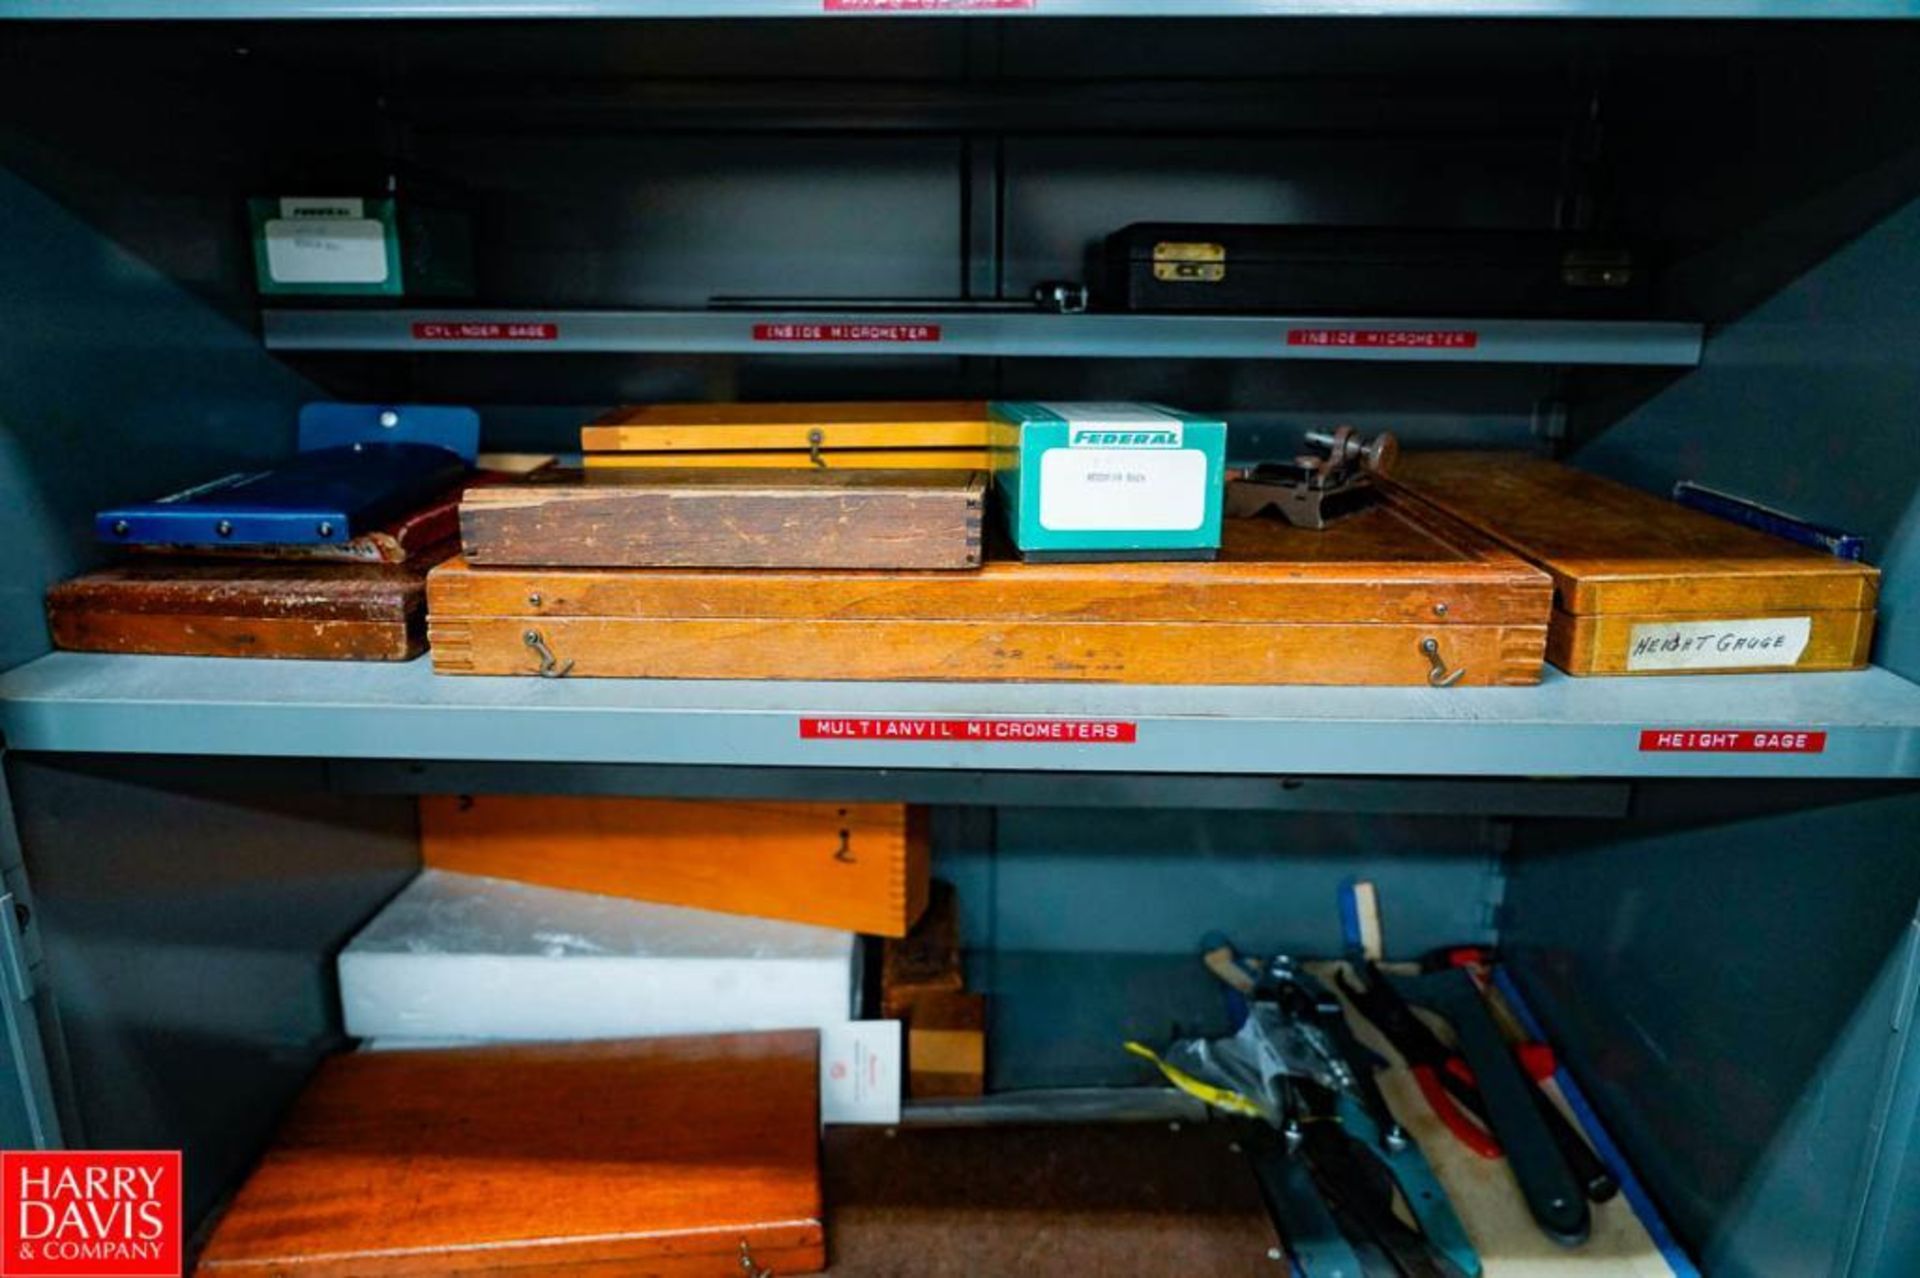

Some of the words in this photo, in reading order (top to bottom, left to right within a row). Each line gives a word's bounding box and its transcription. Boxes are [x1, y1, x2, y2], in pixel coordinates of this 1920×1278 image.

[424, 325, 500, 337] CYLINDER
[766, 326, 821, 338] INSIDE
[830, 326, 928, 339] MICROMETER
[1301, 331, 1356, 344] INSIDE
[1367, 332, 1465, 346] MICROMETER
[1074, 430, 1179, 445] FEDERAL
[1717, 633, 1786, 652] GAUGE
[816, 720, 951, 736] MULTIANVIL
[967, 722, 1119, 739] MICROMETERS
[1657, 733, 1740, 748] HEIGHT
[1753, 734, 1808, 748] GAGE
